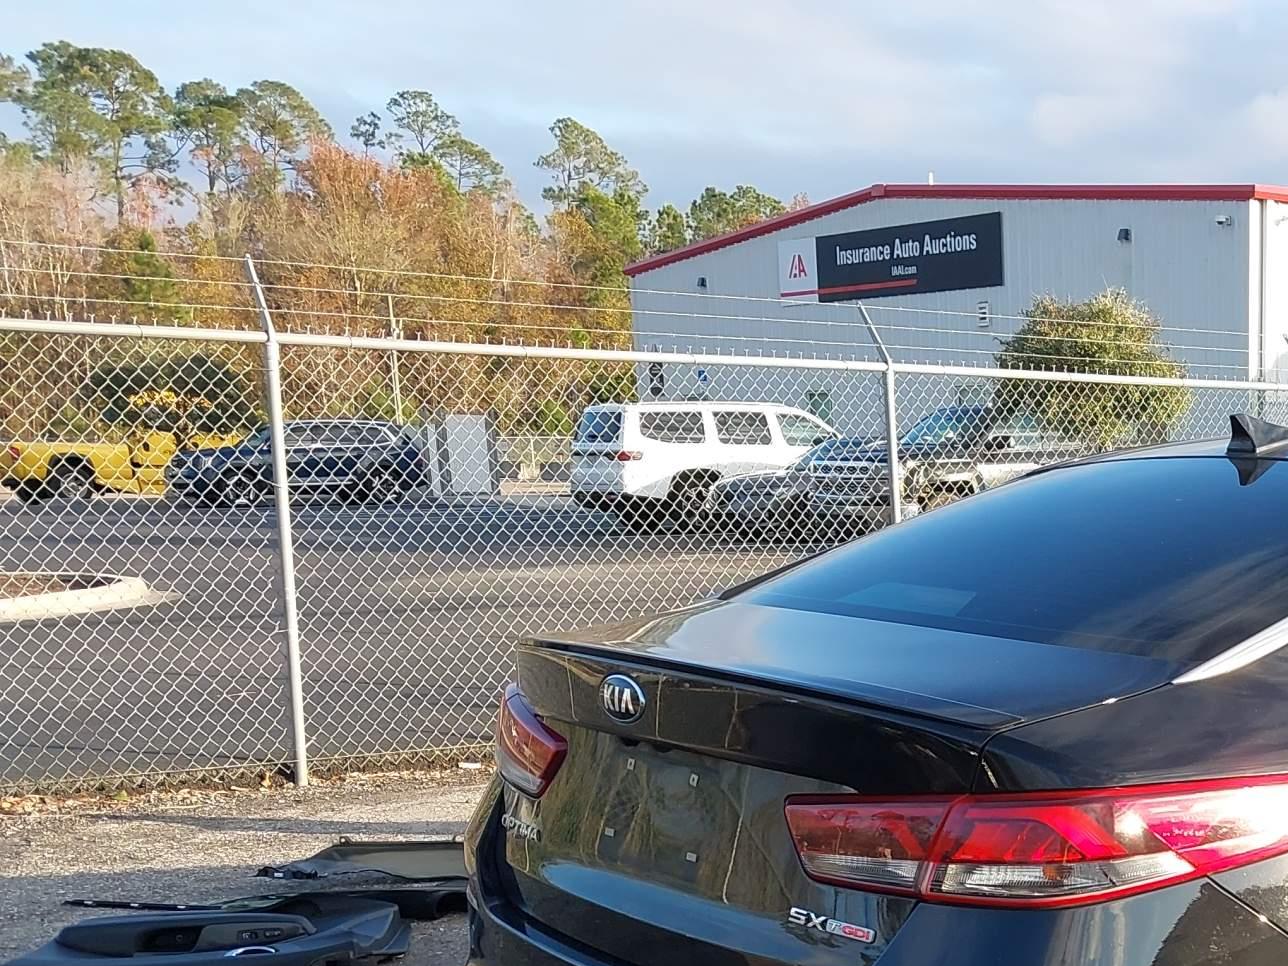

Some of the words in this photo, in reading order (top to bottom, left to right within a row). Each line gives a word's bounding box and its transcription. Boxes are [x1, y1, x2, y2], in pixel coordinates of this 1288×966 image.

[836, 244, 891, 266] Insurance
[893, 238, 920, 259] Auto
[922, 231, 977, 256] Auctions
[603, 683, 636, 715] KIA
